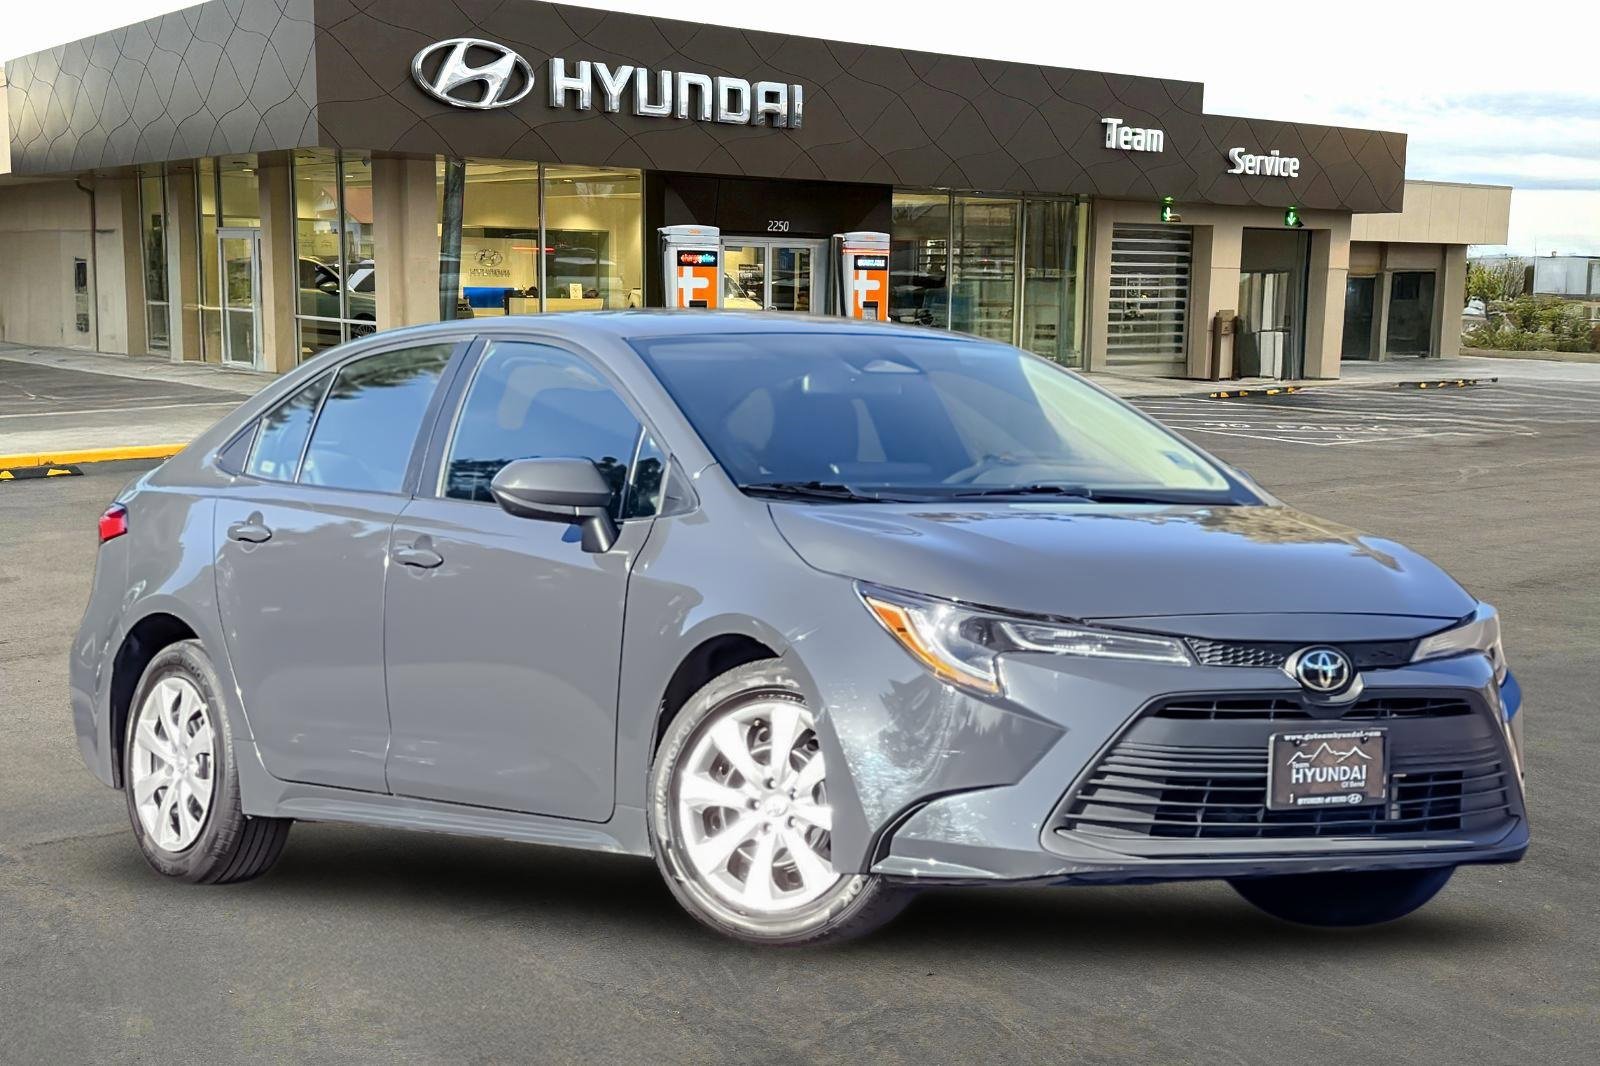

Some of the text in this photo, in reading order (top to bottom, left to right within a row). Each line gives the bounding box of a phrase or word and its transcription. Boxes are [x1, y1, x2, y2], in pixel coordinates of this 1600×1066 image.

[549, 57, 803, 128] HYUNDAI
[1102, 117, 1164, 152] Team
[1228, 147, 1299, 178] Service
[767, 220, 789, 232] 2250
[1291, 764, 1367, 784] HYUNDAI
